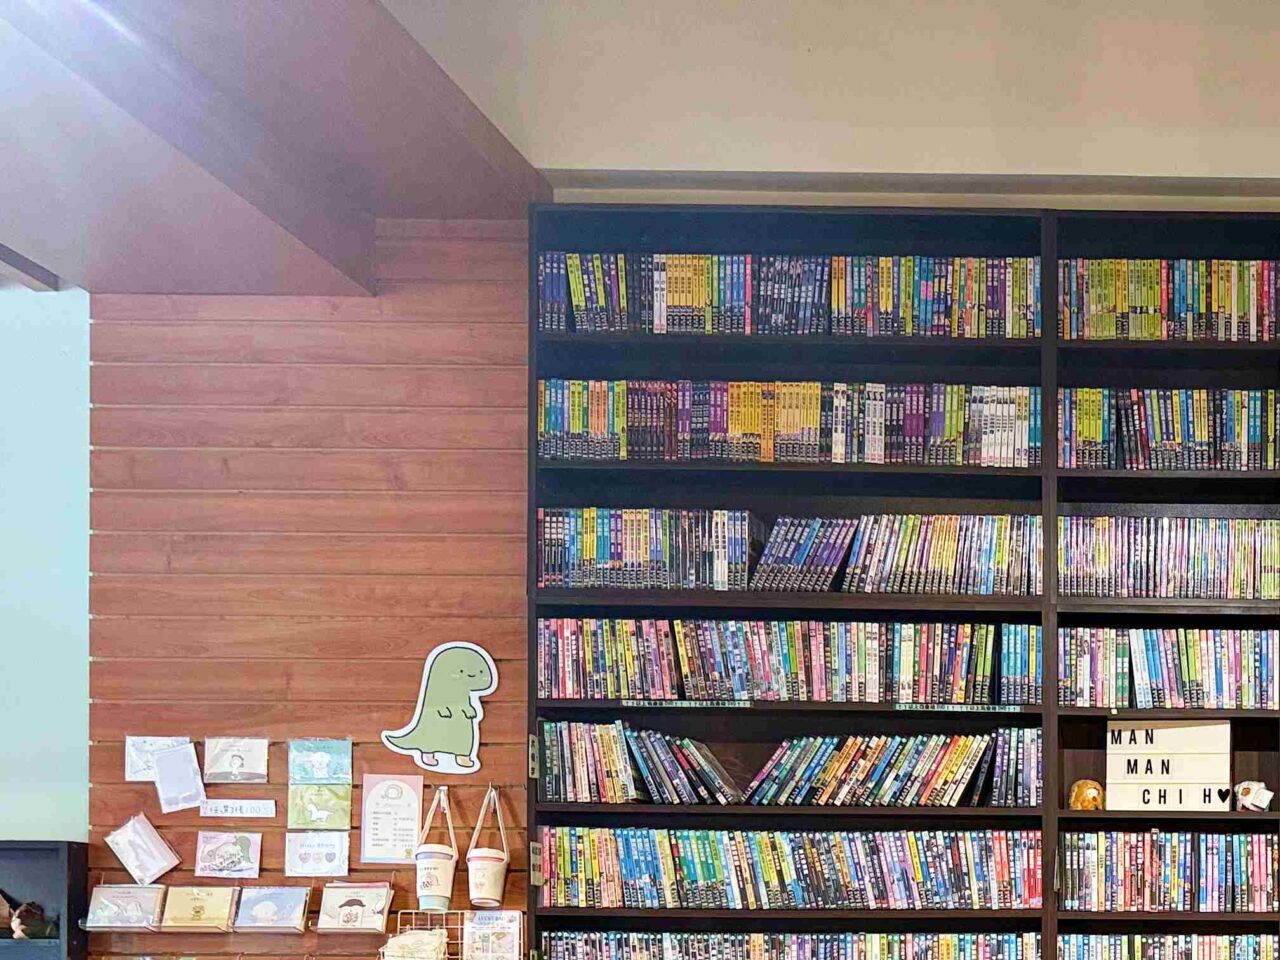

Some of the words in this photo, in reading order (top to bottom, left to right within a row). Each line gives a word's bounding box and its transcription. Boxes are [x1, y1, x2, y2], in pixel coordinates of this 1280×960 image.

[1110, 728, 1154, 745] MAN
[1126, 758, 1170, 775] MAN
[1142, 788, 1183, 805] CHI
